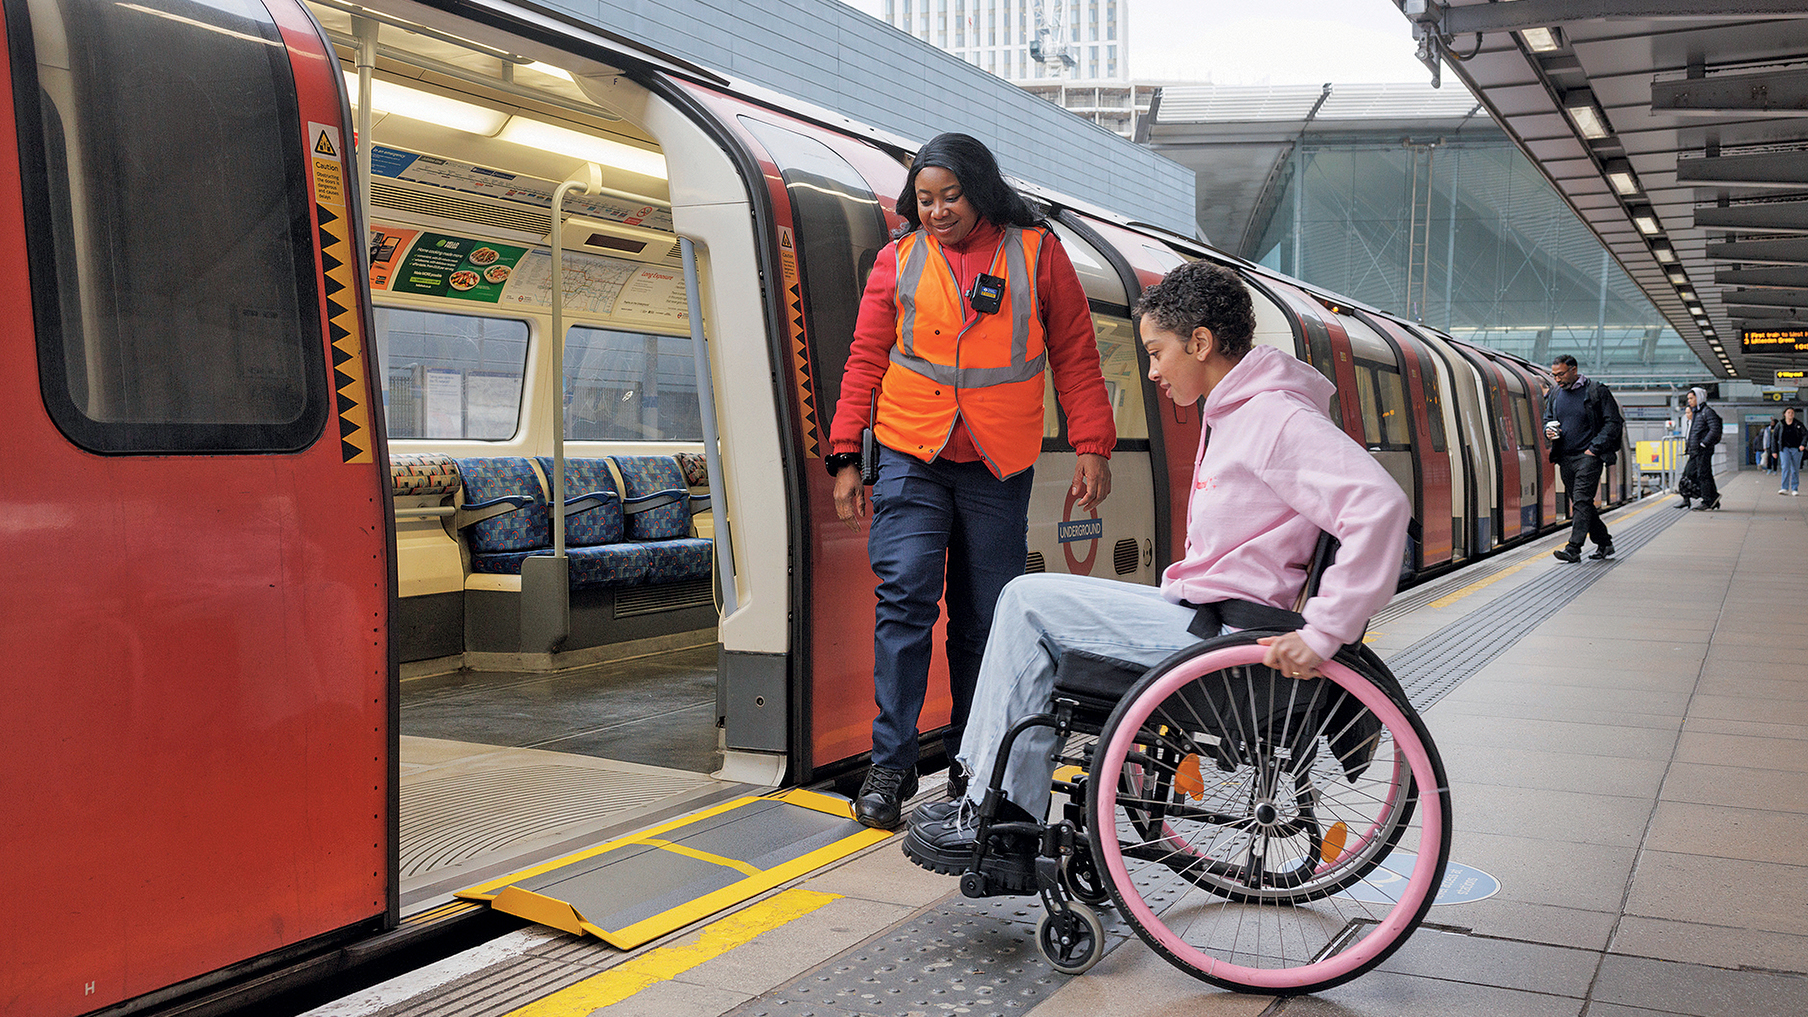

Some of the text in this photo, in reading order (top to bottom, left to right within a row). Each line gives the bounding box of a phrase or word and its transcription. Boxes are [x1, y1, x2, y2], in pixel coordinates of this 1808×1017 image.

[316, 162, 338, 171] Caution
[316, 172, 340, 180] Obstructing
[642, 270, 674, 280] Long Exposure
[1060, 522, 1101, 538] UNDERGROUND
[85, 980, 95, 996] H
